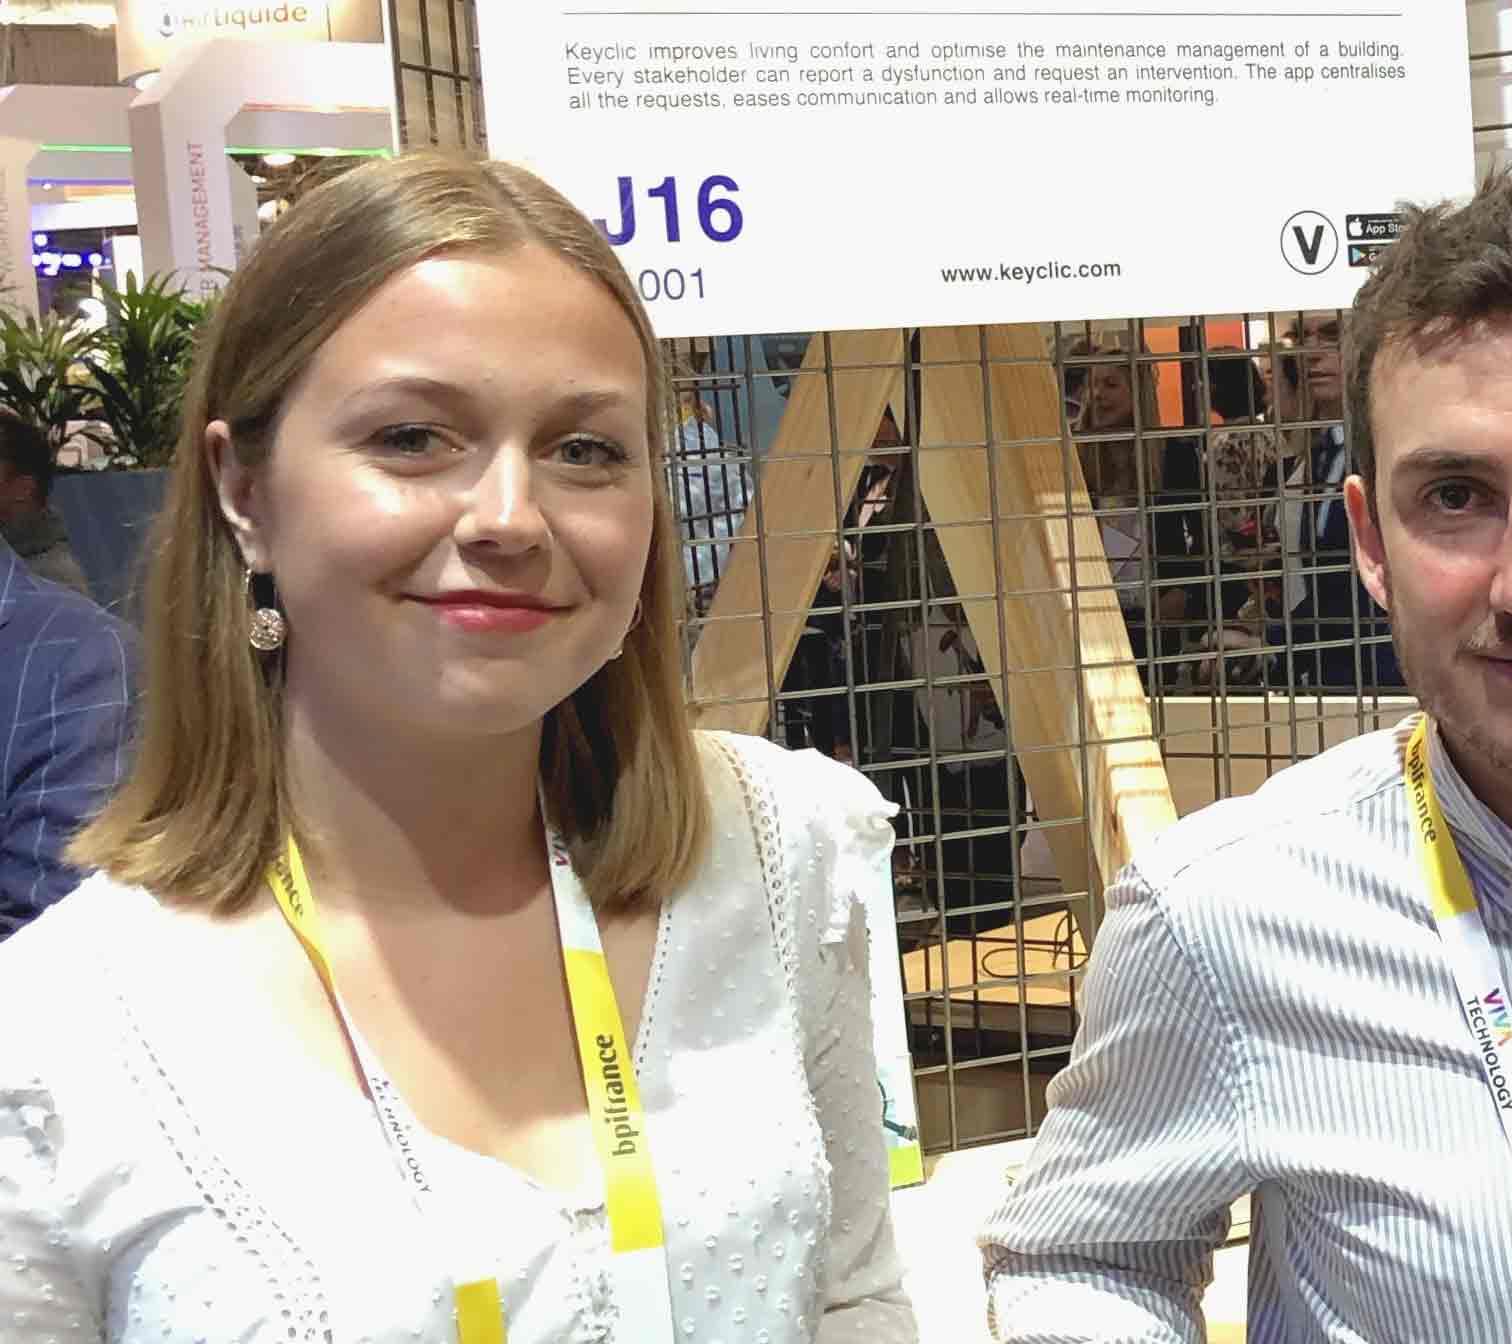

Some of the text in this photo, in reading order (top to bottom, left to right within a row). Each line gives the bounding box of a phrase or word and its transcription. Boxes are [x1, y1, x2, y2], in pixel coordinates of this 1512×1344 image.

[564, 41, 1405, 62] Keyclic improves living confort and optimise the maintenance management of a building.
[565, 63, 1407, 87] Every stakeholder can report a dysfunction and request an intervention. The app centralises
[568, 88, 1220, 111] all the requests, eases communication and allows real-time monitoring.
[592, 174, 744, 246] J16
[1365, 223, 1386, 235] App
[638, 267, 704, 301] 001
[940, 261, 1121, 285] www.keyclic.com
[598, 1033, 636, 1157] bpifrance
